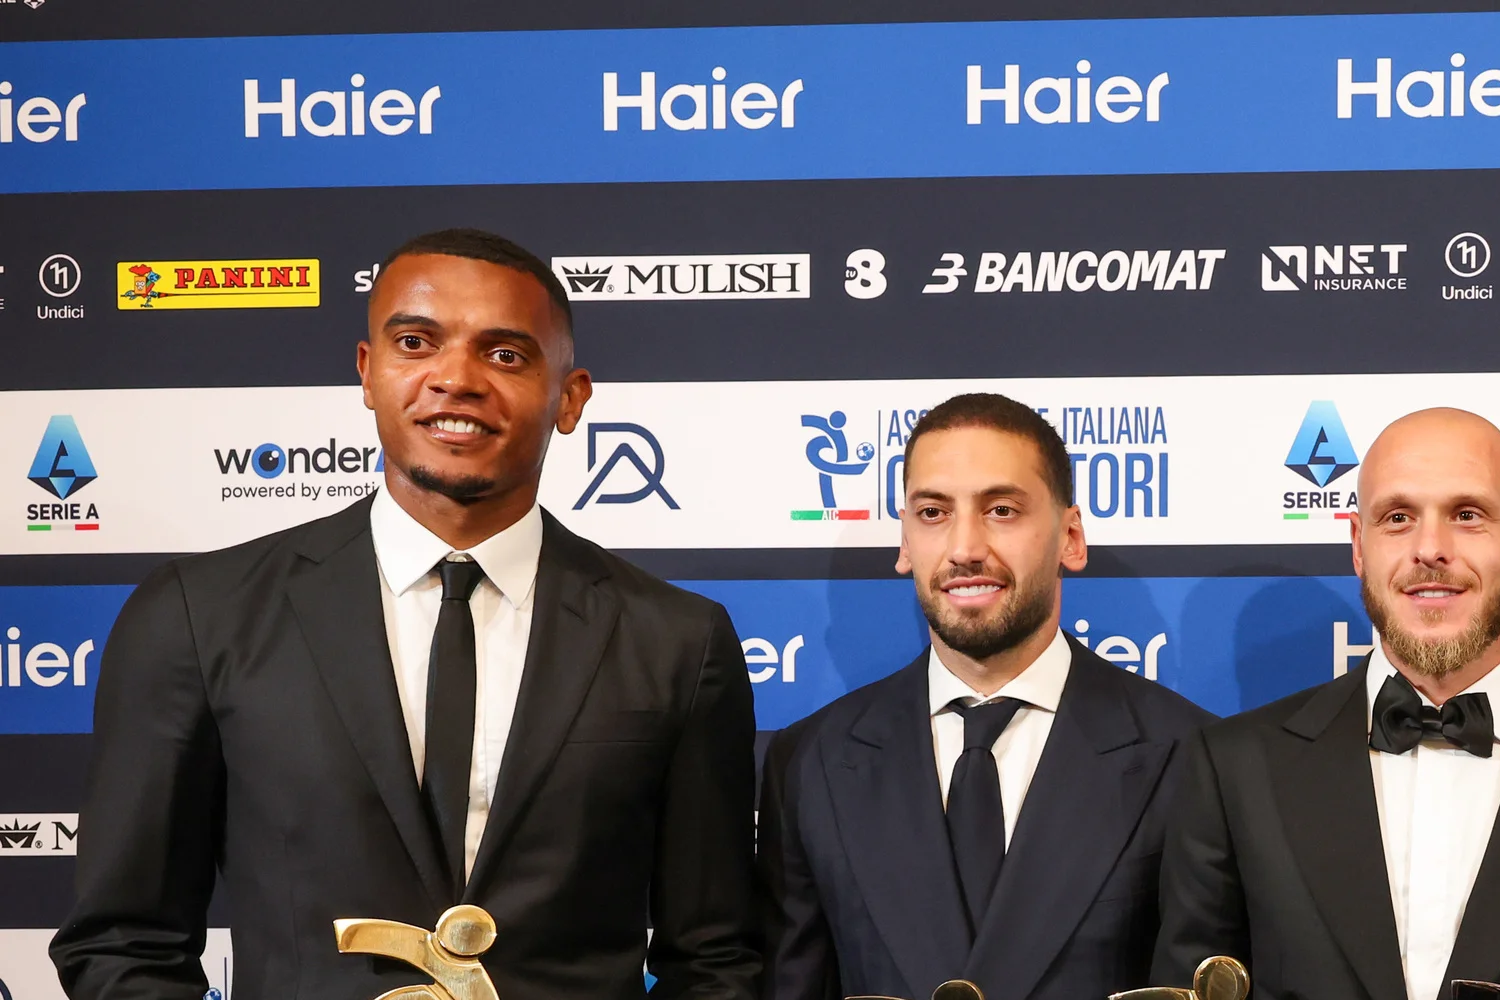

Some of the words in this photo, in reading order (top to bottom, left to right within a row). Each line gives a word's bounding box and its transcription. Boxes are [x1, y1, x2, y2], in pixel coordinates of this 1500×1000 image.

[243, 73, 441, 138] Haier
[603, 66, 804, 132] Haier
[966, 59, 1169, 125] Haier
[0, 81, 86, 143] ier
[973, 249, 1226, 293] BANCOMAT
[1315, 244, 1407, 275] NET
[174, 265, 311, 289] PANINI
[623, 262, 801, 294] MULISH
[1314, 278, 1407, 291] INSURANCE
[1441, 285, 1493, 300] Undici
[36, 305, 84, 319] Undici
[214, 438, 377, 479] wonder
[221, 482, 296, 502] powered
[300, 482, 322, 501] by
[326, 481, 379, 497] emoti
[1283, 492, 1338, 509] SERIE
[27, 503, 81, 521] SERIE
[85, 503, 100, 520] A
[0, 626, 94, 688] ier
